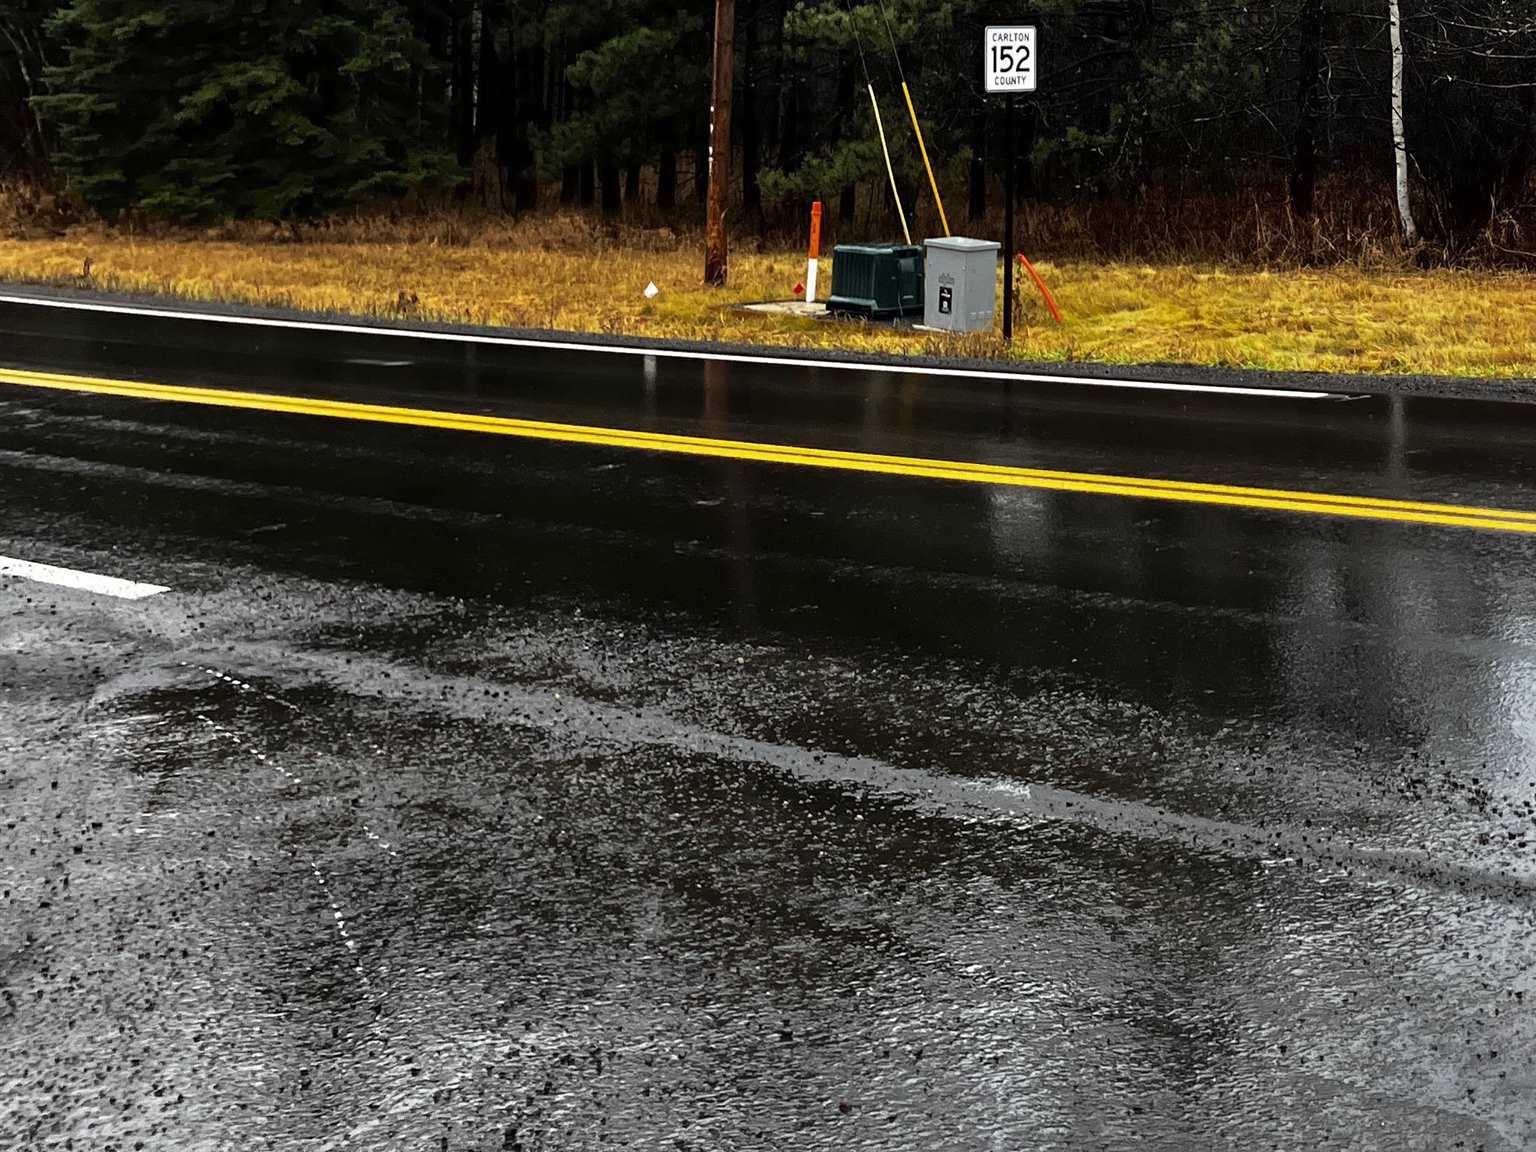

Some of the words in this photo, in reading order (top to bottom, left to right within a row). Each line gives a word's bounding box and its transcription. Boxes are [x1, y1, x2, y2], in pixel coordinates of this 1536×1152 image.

[992, 32, 1030, 42] CARLTON
[991, 45, 1030, 73] 152
[994, 76, 1027, 86] COUNTY
